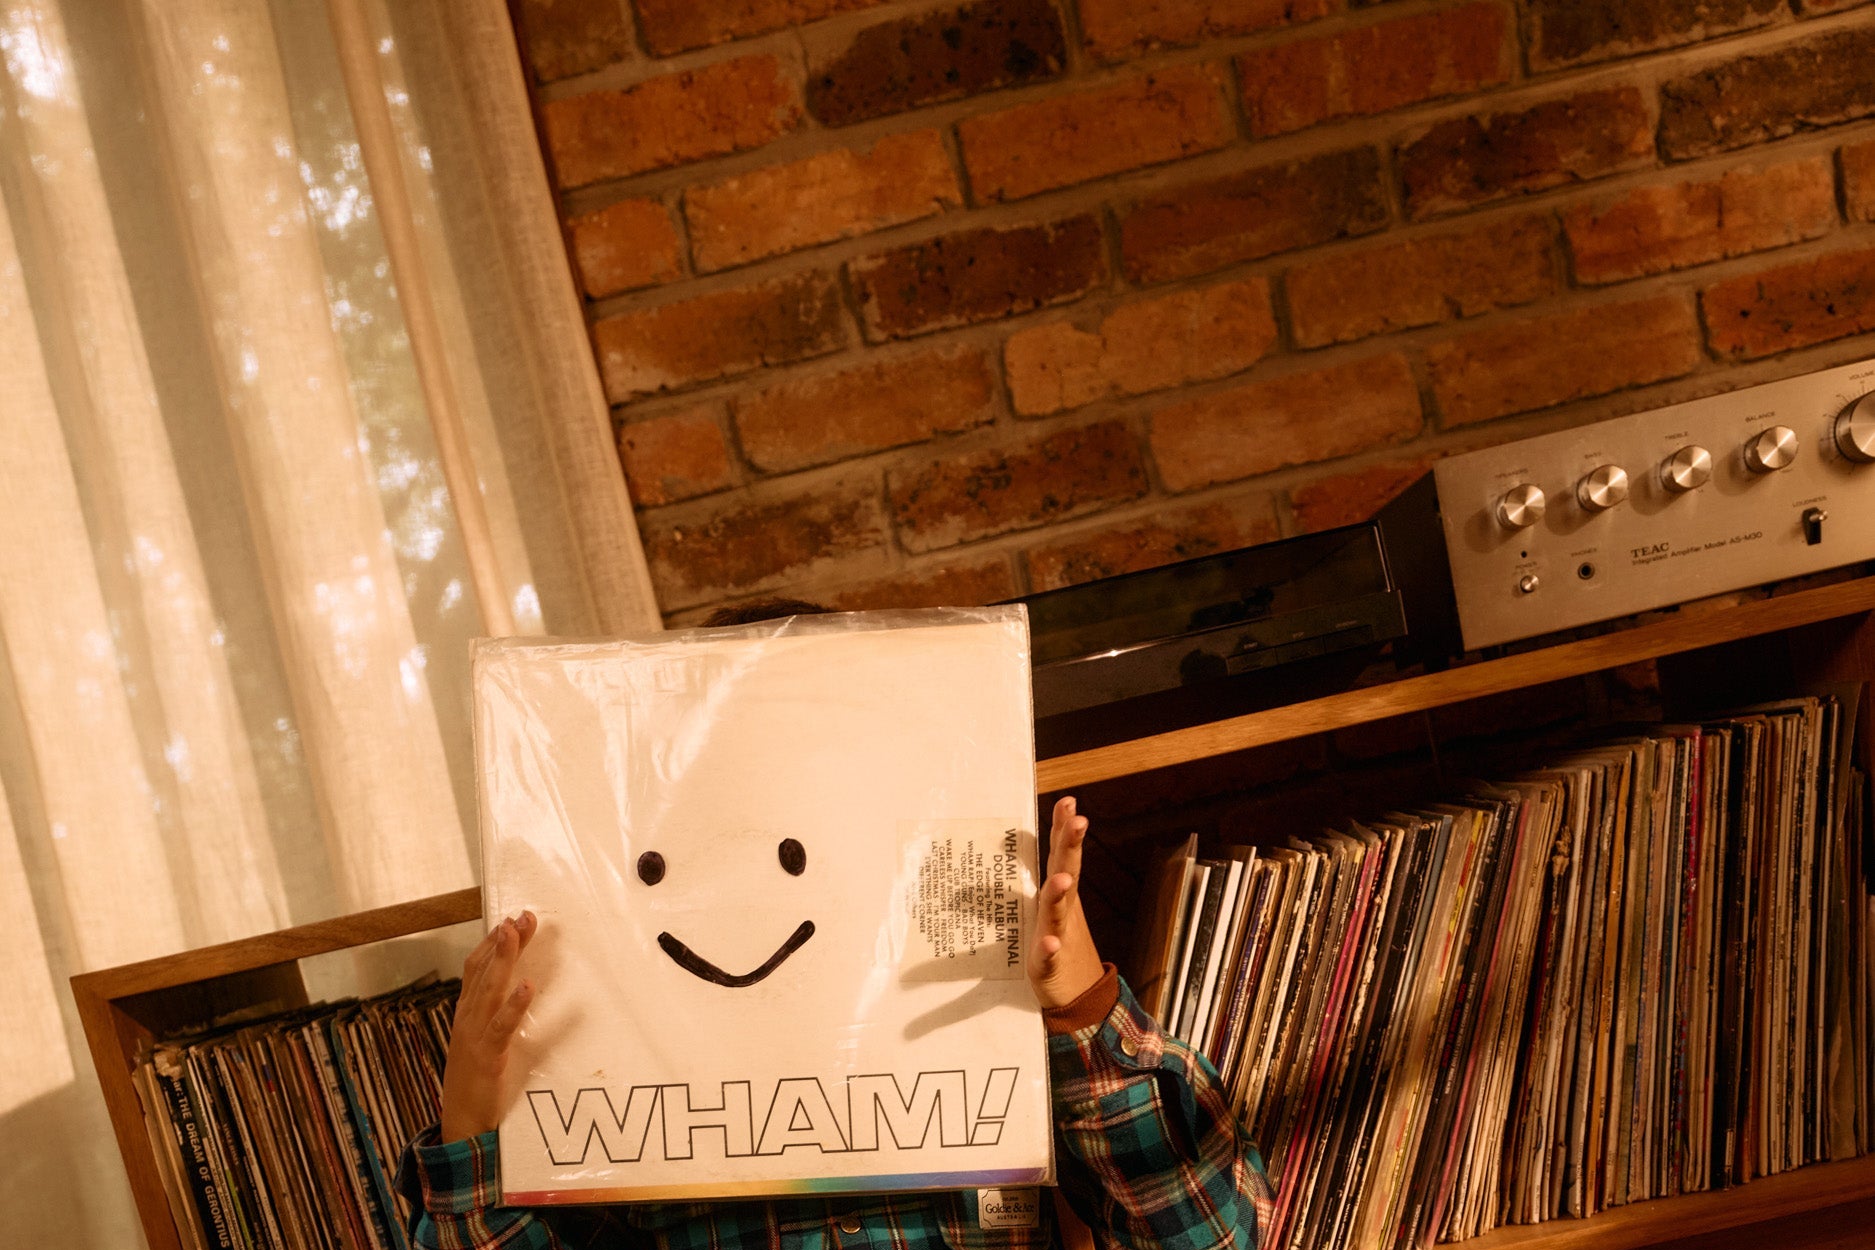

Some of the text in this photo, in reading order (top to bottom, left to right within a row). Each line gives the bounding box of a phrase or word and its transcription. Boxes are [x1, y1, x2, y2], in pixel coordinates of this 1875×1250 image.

[1745, 411, 1776, 423] BALANCE
[1792, 496, 1828, 508] LOUDNESS
[1630, 542, 1670, 559] TEAC
[1631, 531, 1764, 566] Integrated Amplifier Model AS-M30
[1005, 828, 1017, 880] WHAM!
[924, 856, 932, 900] EVERYTHING
[946, 862, 953, 873] ME
[946, 874, 953, 885] UP
[984, 867, 992, 899] Featuring
[975, 853, 985, 943] THE EDGE OF HEAVEN
[993, 855, 1005, 942] DOUBLE ALBUM
[1006, 899, 1018, 923] THE
[948, 931, 955, 944] GO
[1007, 928, 1020, 968] FINAL
[948, 946, 955, 959] GO
[178, 1097, 192, 1119] THE
[526, 1067, 1019, 1166] WHAM!
[185, 1122, 206, 1164] DREAM
[198, 1166, 211, 1181] OF
[204, 1185, 231, 1249] GERONTIUS
[985, 1203, 1012, 1214] Goldie
[1013, 1202, 1022, 1213] &
